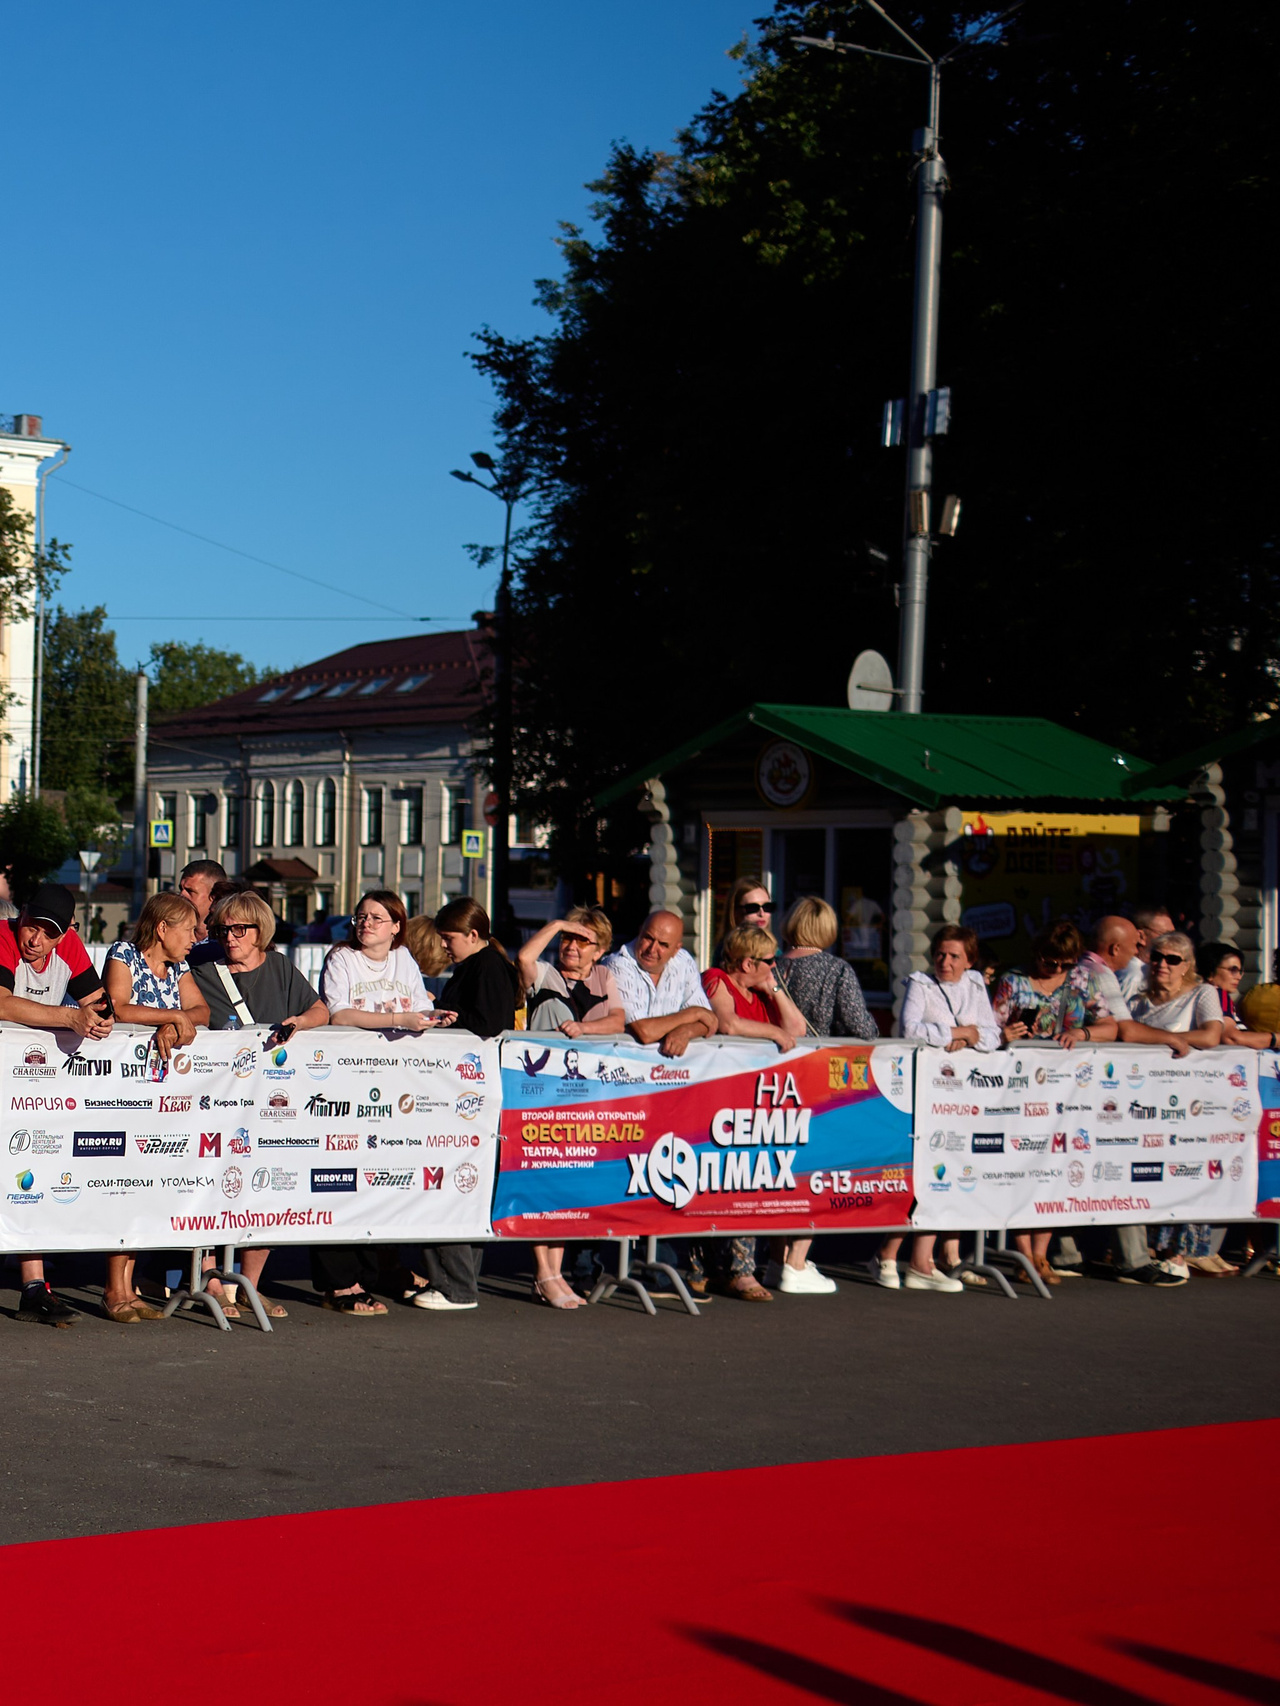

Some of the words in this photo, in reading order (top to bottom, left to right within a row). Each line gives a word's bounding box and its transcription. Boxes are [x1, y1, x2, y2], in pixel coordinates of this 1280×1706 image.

[231, 1051, 257, 1071] МОРЕ
[13, 1068, 57, 1076] CHARUSHIN
[121, 1063, 145, 1078] ВЯТ
[521, 1086, 544, 1095] ТЕАТР
[755, 1072, 802, 1107] НА
[11, 1097, 63, 1110] МАРИЯ
[214, 1100, 237, 1108] Киров
[357, 1104, 392, 1118] ВЯТИЧ
[522, 1110, 554, 1120] ВТОРОЙ
[556, 1110, 595, 1120] ВЯТСКИЙ
[597, 1110, 646, 1120] ОТКРЫТЫЙ
[522, 1123, 645, 1143] ФЕСТИВАЛЬ
[710, 1108, 812, 1147] СЕМИ
[77, 1138, 122, 1146] KIROV.RU
[426, 1135, 469, 1148] МАРИЯ
[522, 1146, 563, 1158] ТЕАТРА,
[565, 1146, 597, 1156] КИНО
[531, 1161, 594, 1169] ЖУРНАЛИСТИКИ
[314, 1174, 354, 1182] KIROV.RU
[809, 1170, 851, 1194] 6-13
[854, 1179, 908, 1194] АВГУСТА
[882, 1168, 905, 1180] 2023
[7, 1192, 44, 1200] ПЕРВЫЙ
[829, 1197, 873, 1209] КИРОВ
[170, 1208, 333, 1231] www.7holmovfest.ru
